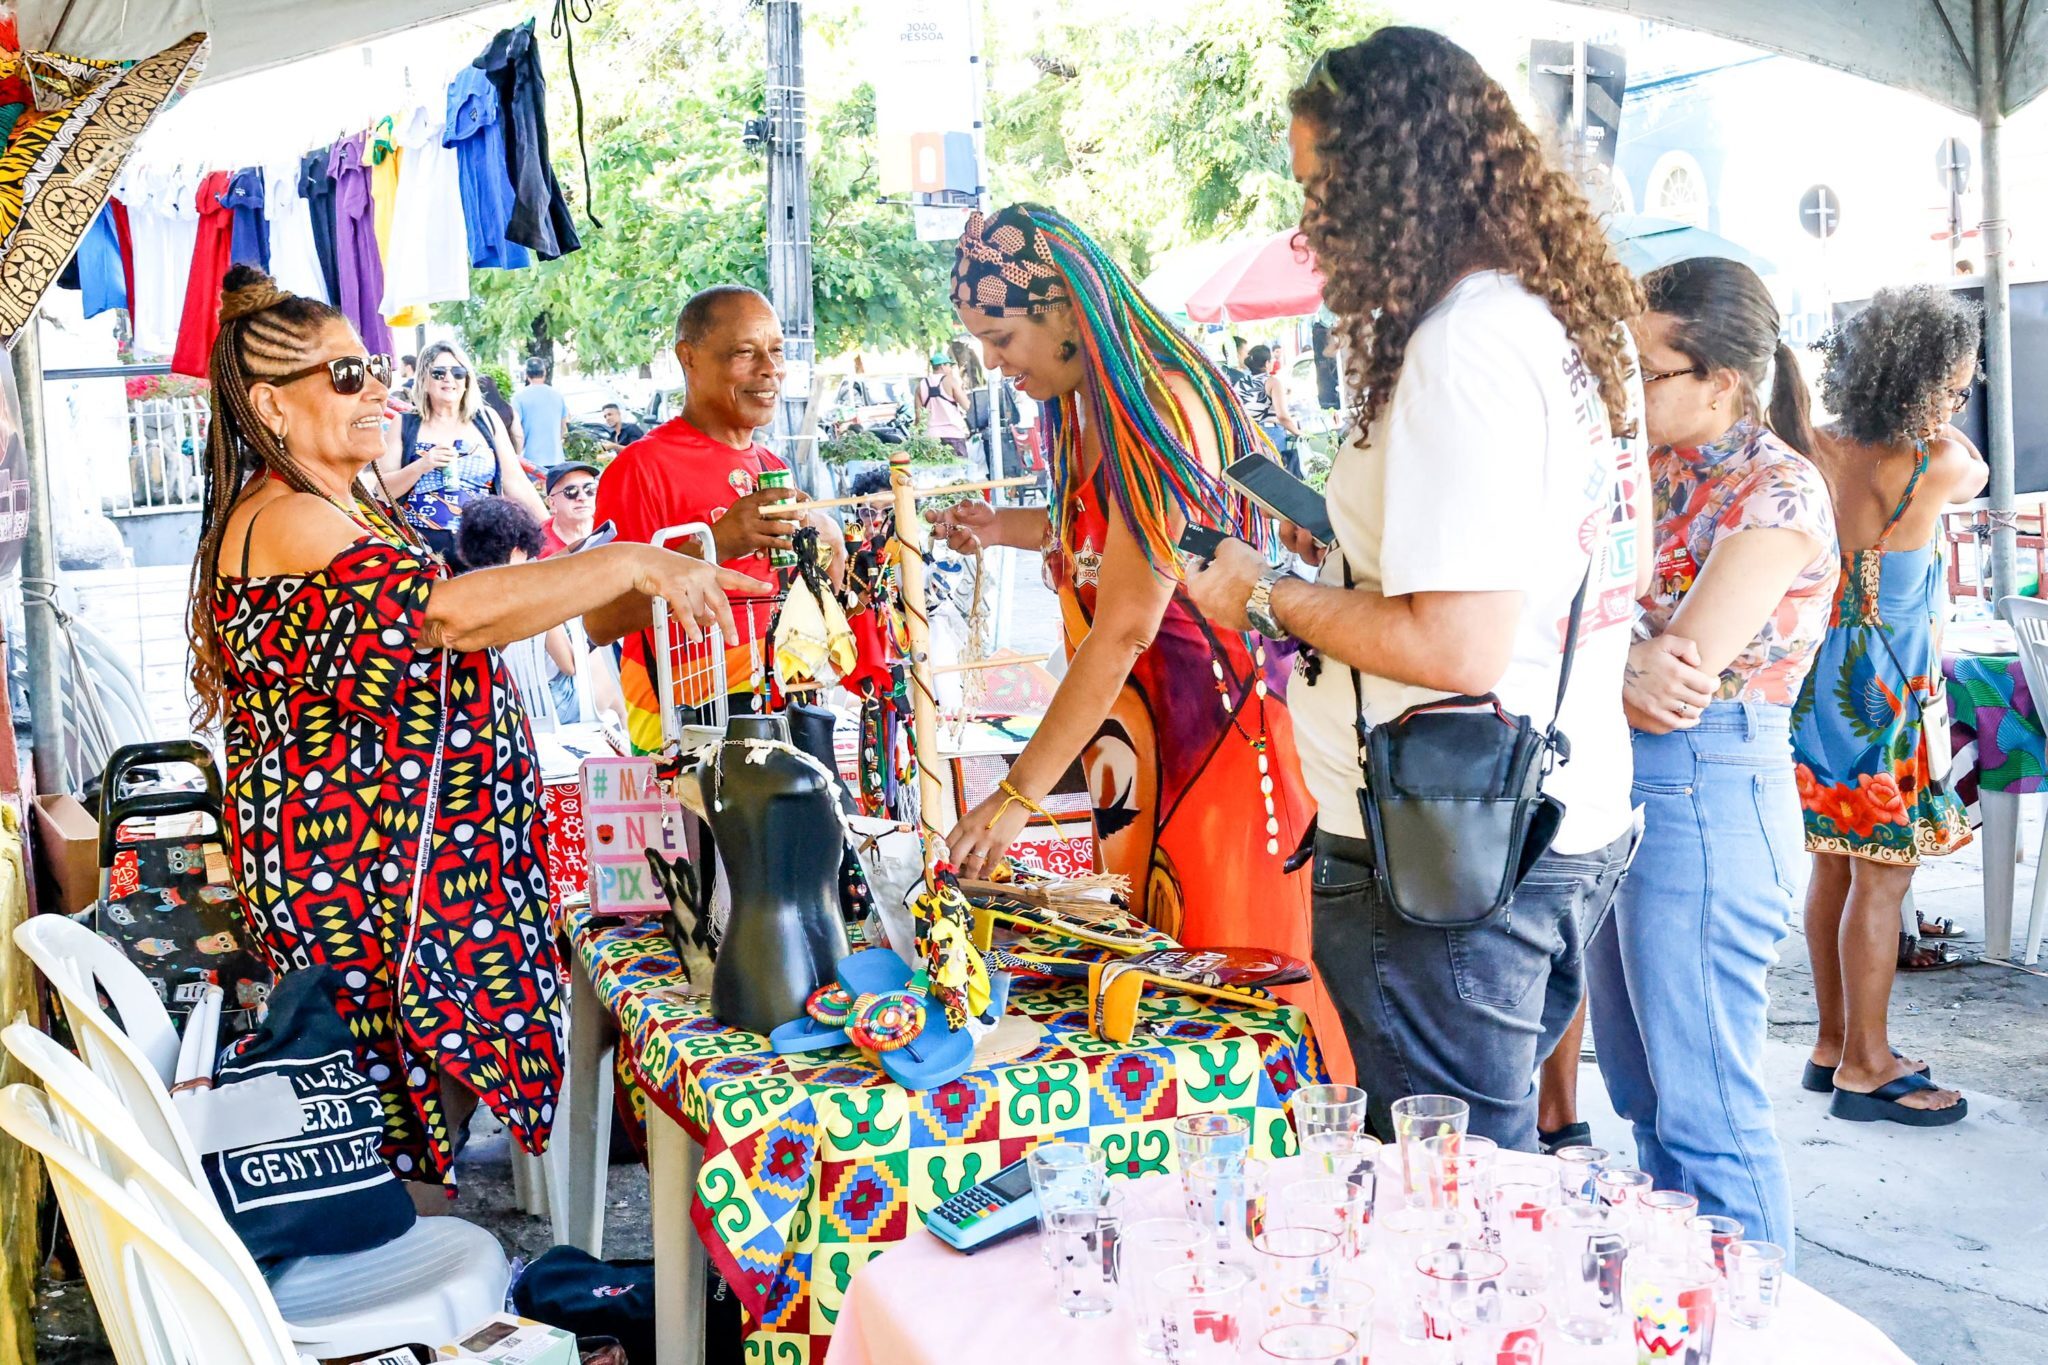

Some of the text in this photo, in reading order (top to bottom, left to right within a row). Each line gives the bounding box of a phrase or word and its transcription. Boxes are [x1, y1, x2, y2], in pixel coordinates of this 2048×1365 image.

[900, 32, 944, 41] PESSOA
[1188, 523, 1203, 533] VISA
[601, 867, 645, 901] PIX
[301, 1099, 353, 1132] ERA
